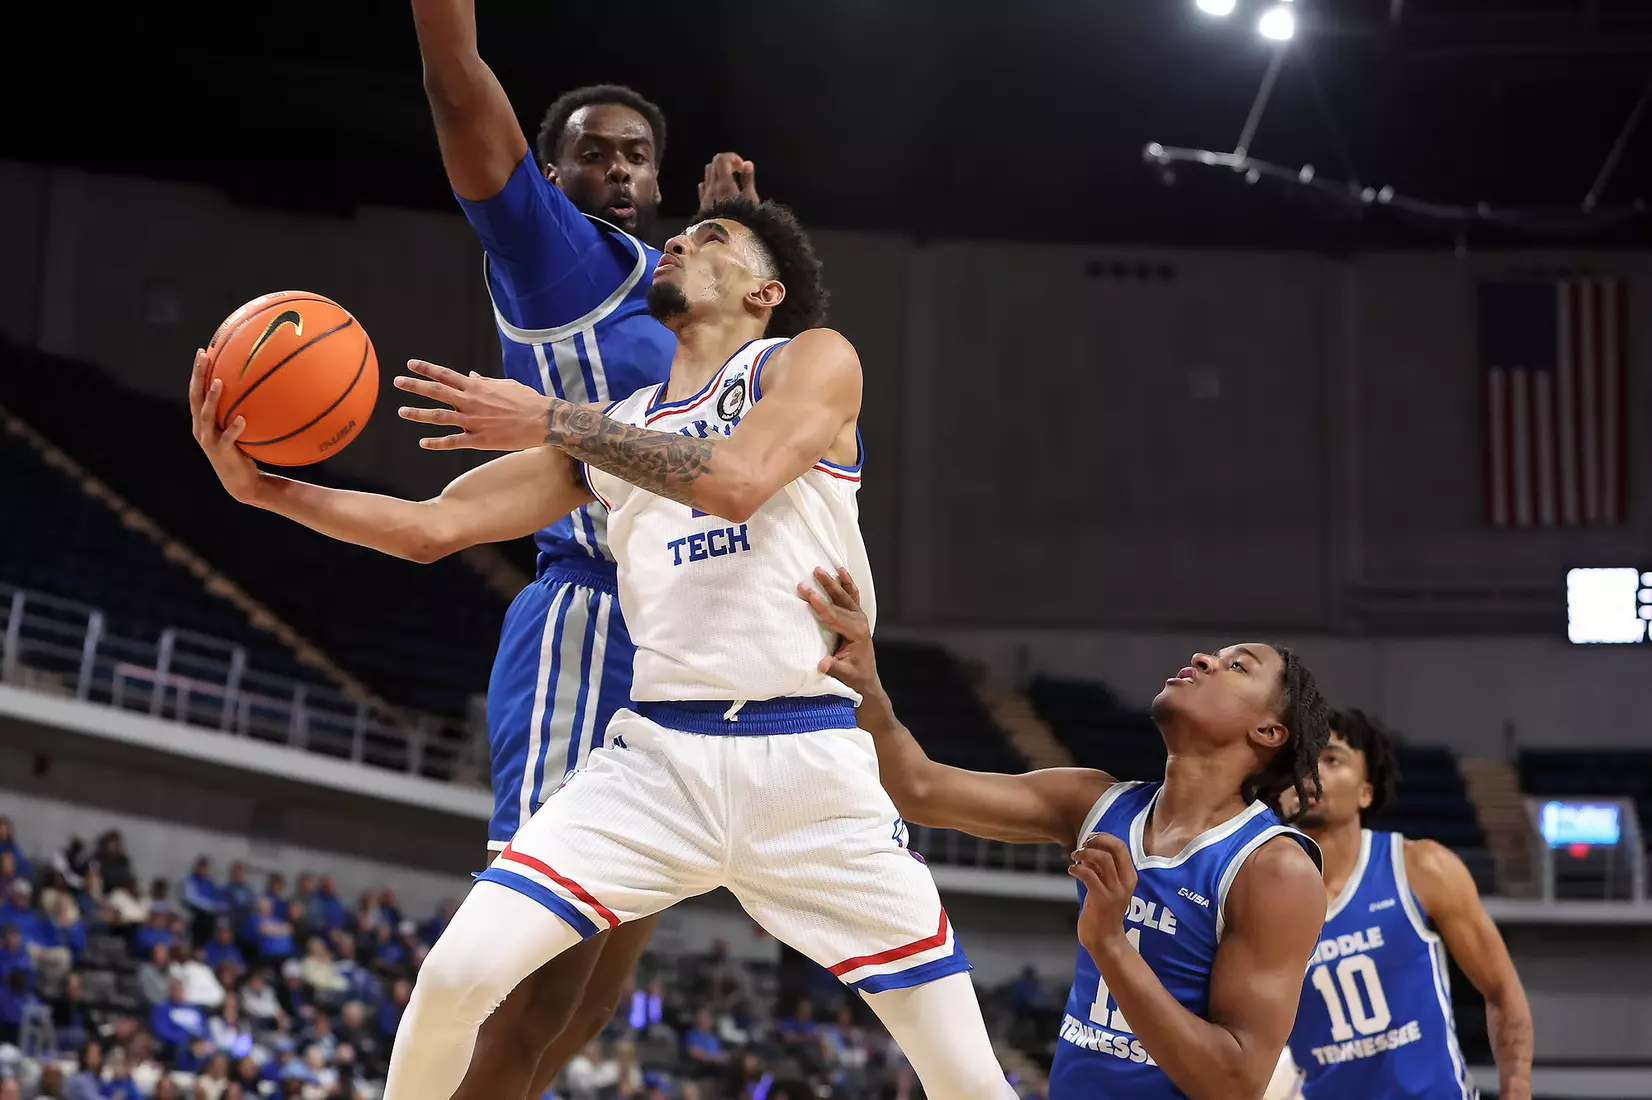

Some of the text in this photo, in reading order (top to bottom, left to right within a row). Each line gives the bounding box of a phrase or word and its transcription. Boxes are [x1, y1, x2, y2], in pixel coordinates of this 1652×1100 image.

[667, 524, 750, 566] TECH
[1125, 895, 1177, 935] DLE
[1311, 953, 1392, 1042] 10
[1311, 1020, 1422, 1066] TENNESSEE
